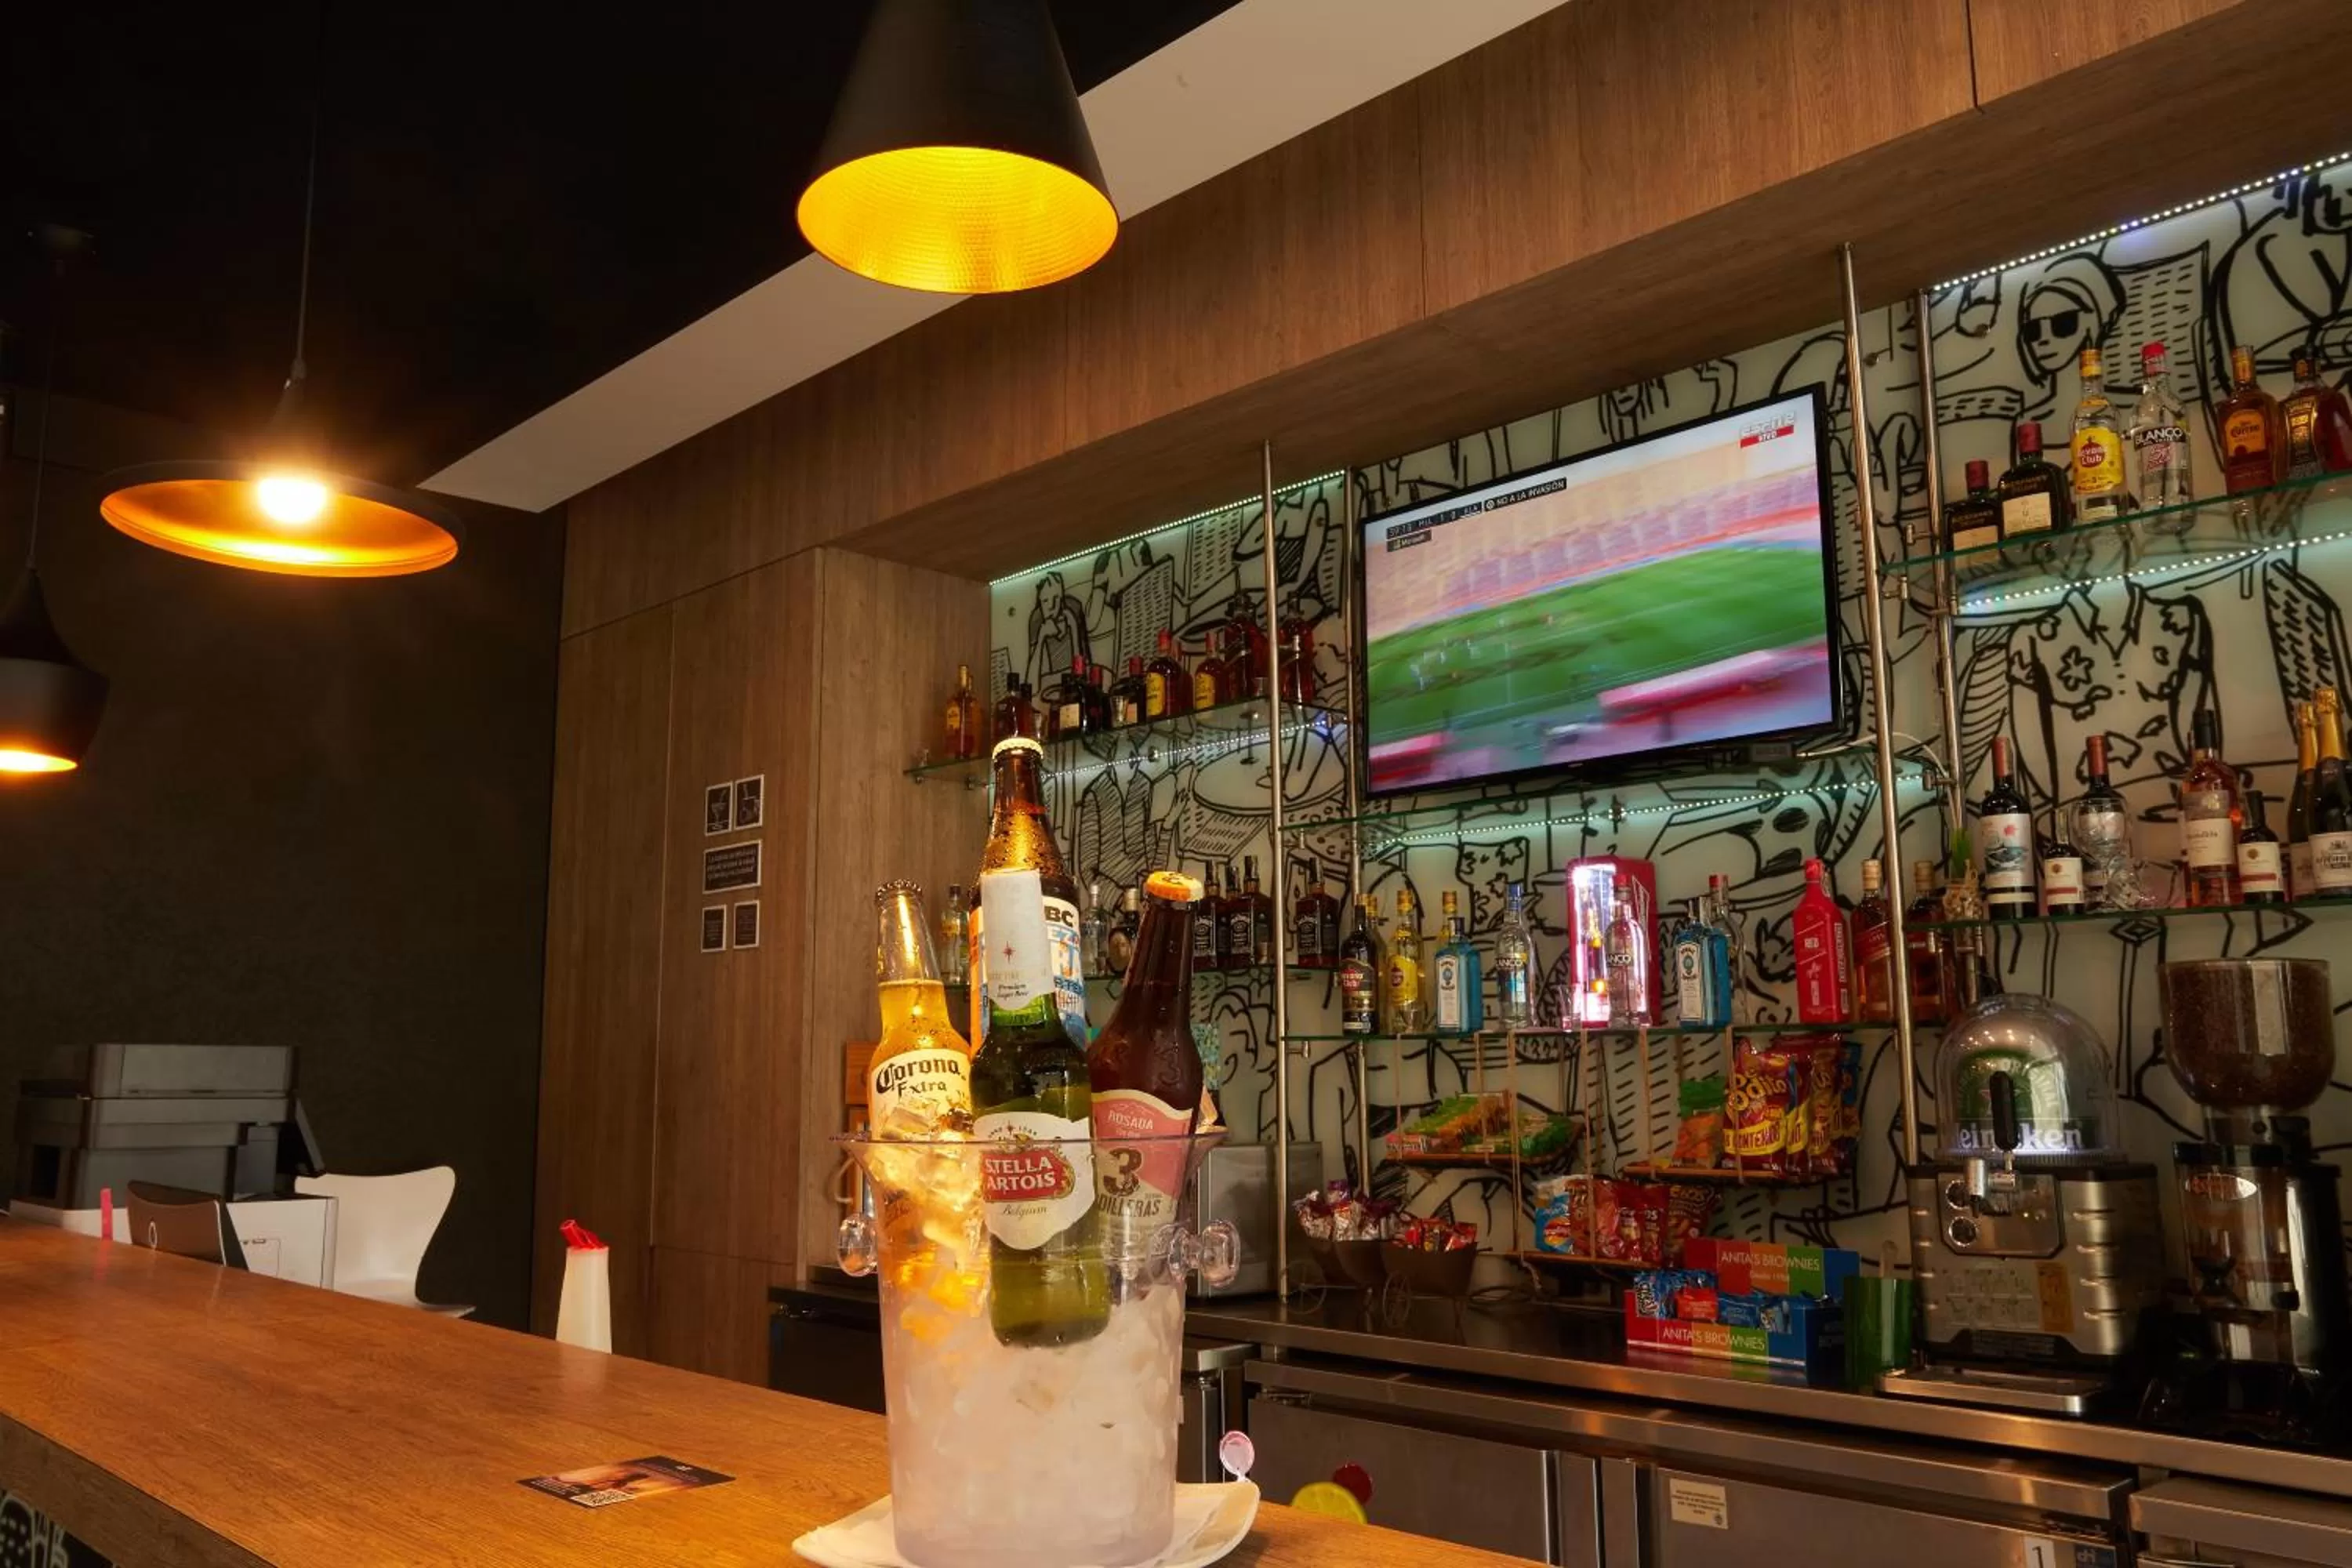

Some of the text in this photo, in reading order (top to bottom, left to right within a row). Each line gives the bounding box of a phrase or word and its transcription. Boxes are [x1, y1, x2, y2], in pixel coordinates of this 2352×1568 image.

[876, 1058, 961, 1094] Corona
[896, 1080, 947, 1098] Extra
[985, 1156, 1054, 1174] STELLA
[1103, 1146, 1144, 1197] 3
[988, 1171, 1056, 1192] ARTOIS
[1721, 1250, 1820, 1271] ANITA'S BROWNIES
[1662, 1326, 1765, 1351] ANITA'S BROWNIES
